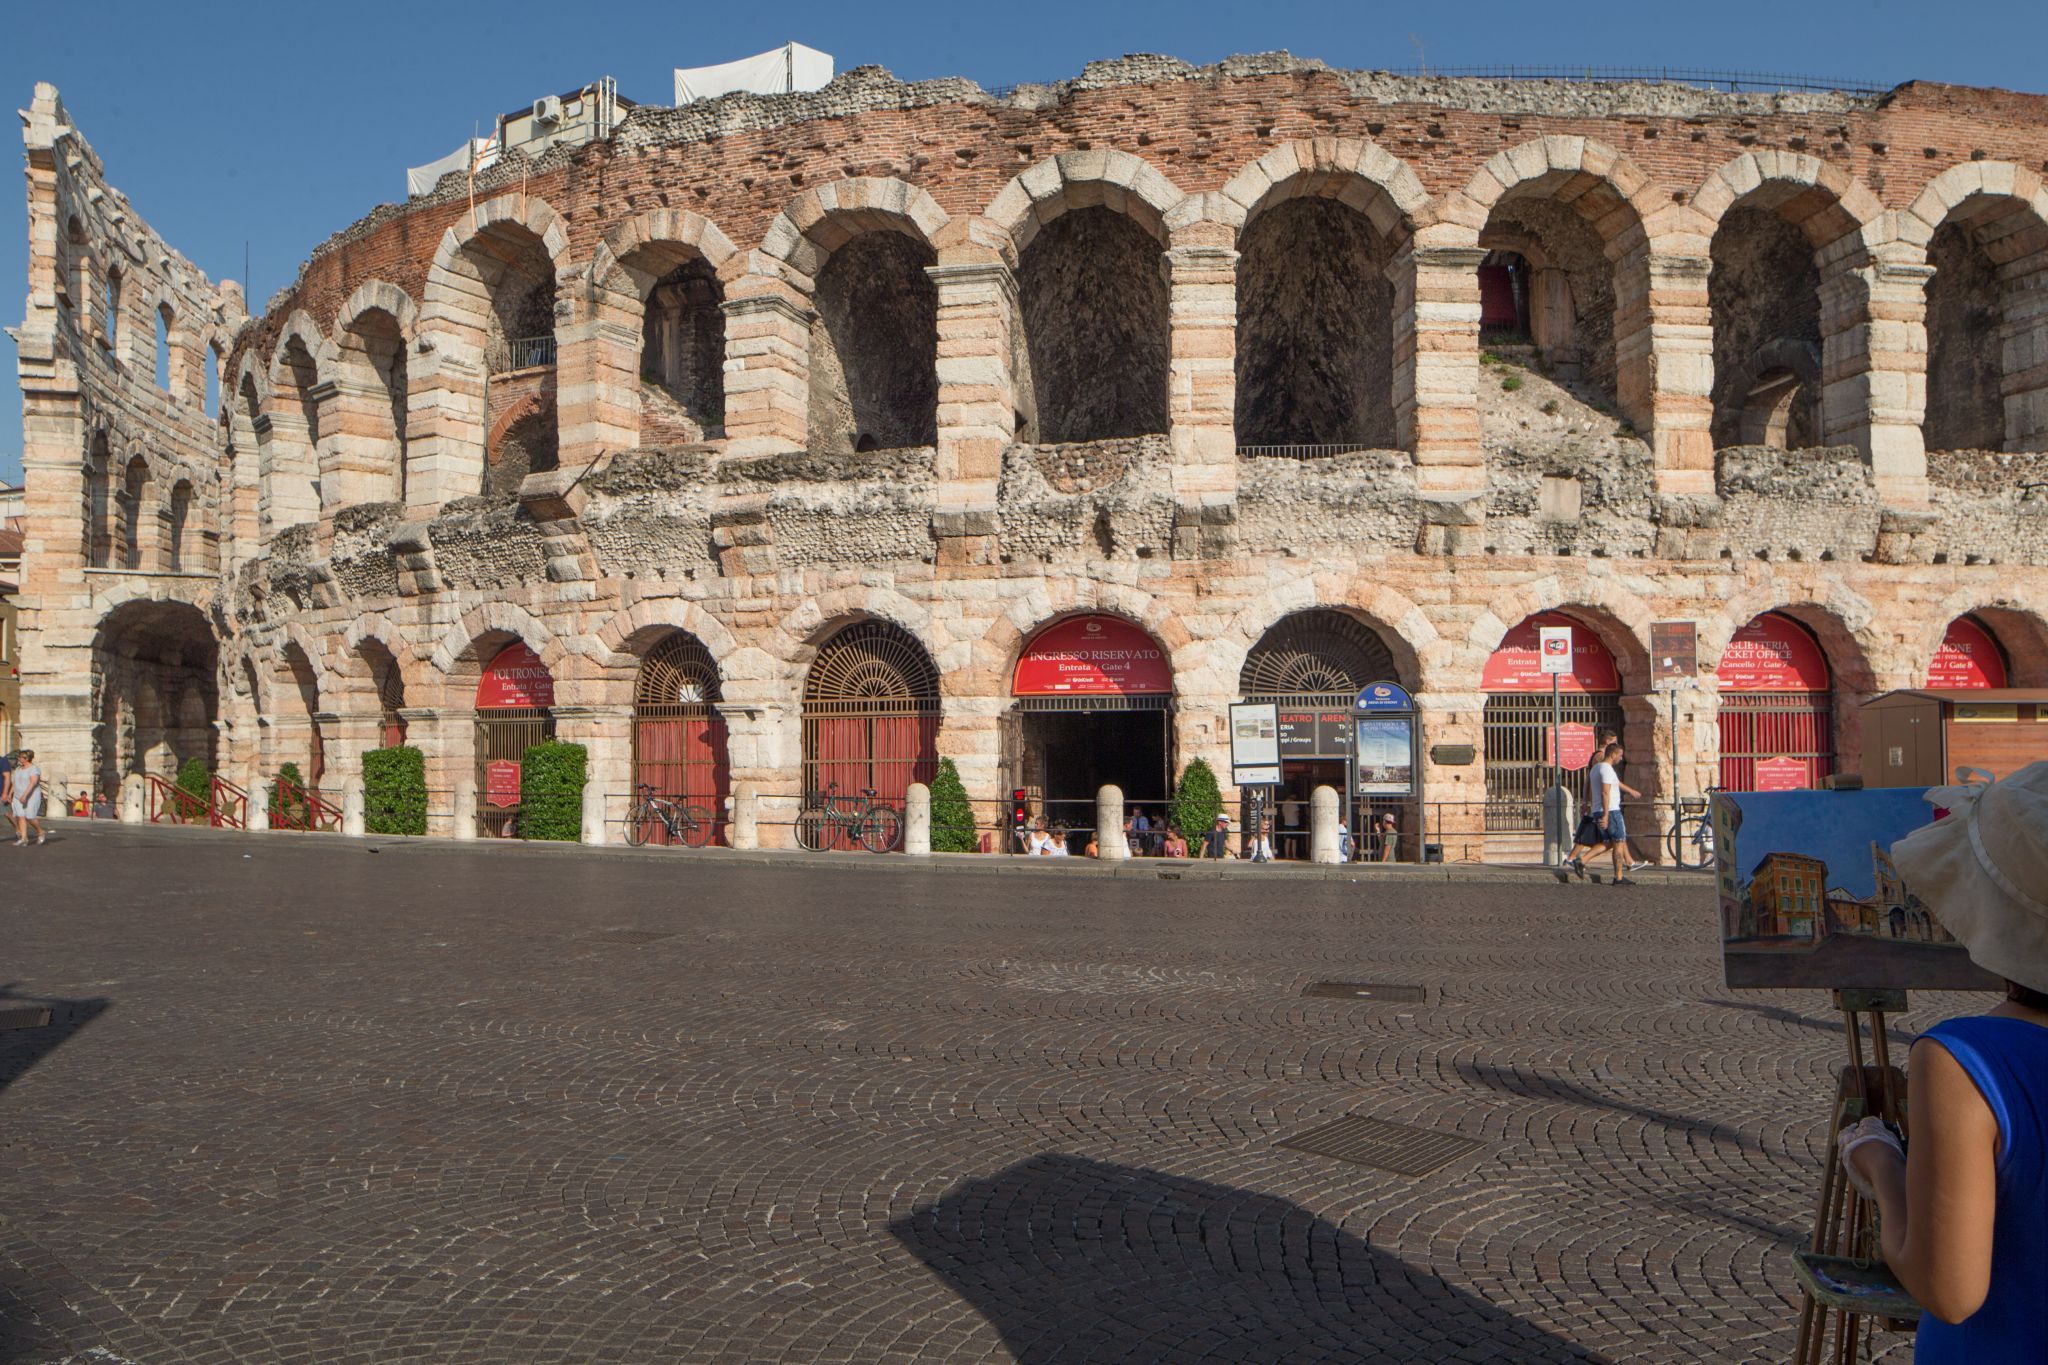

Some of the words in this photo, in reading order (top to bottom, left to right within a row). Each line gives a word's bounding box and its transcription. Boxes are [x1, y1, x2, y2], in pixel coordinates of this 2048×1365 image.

[1030, 651, 1089, 661] INGRESSO
[1091, 650, 1160, 660] RISERVATO
[1756, 650, 1793, 659] OFFICE
[1058, 663, 1091, 671] Entrata
[1123, 662, 1131, 670] 4
[502, 682, 527, 691] Entrata
[1280, 714, 1313, 723] TEATRO
